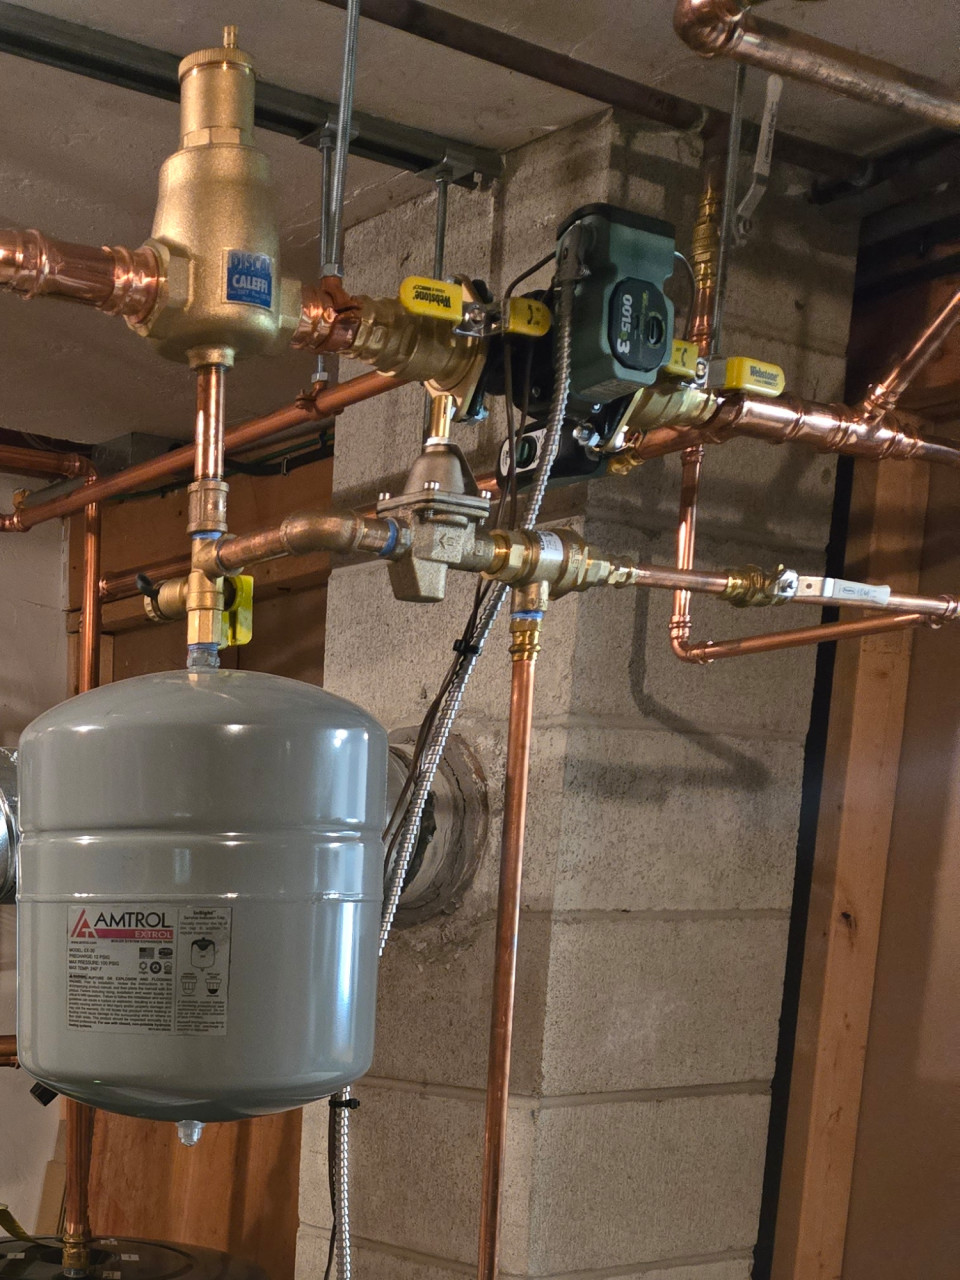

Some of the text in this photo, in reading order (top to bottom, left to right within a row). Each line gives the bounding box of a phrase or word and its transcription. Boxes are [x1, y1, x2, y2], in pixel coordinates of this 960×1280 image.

[232, 274, 269, 294] CALEFFI
[94, 911, 171, 929] AMTROL
[135, 930, 172, 939] EXTROL
